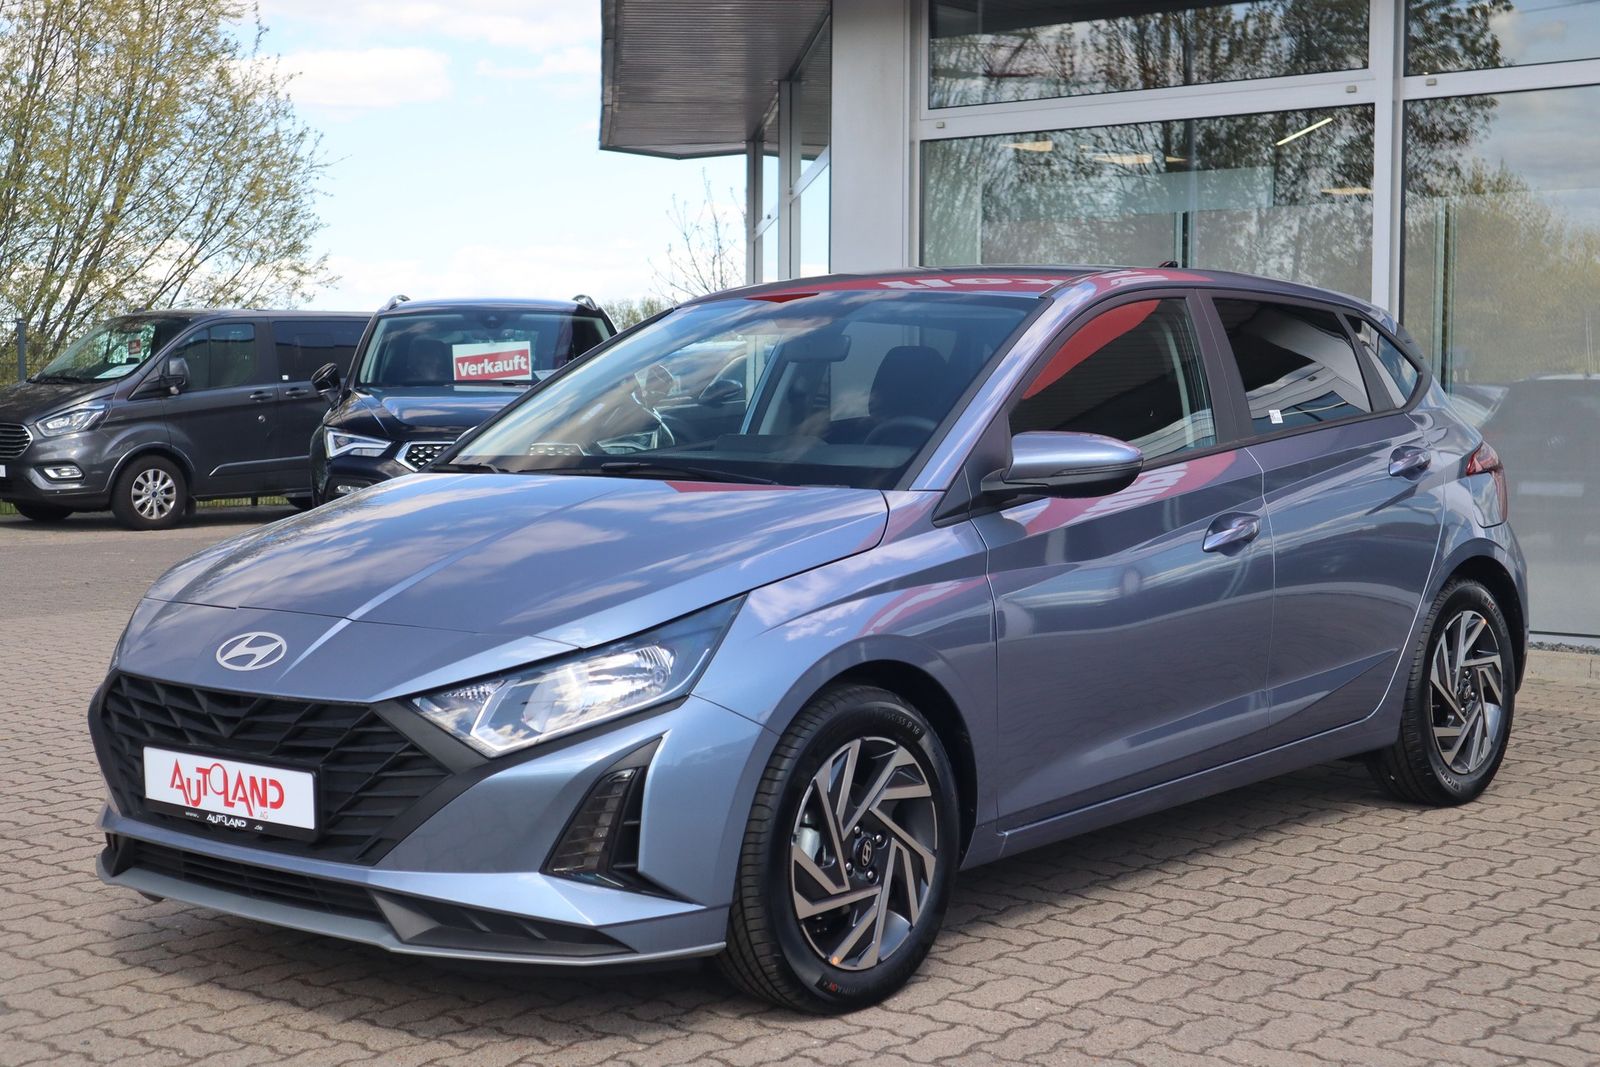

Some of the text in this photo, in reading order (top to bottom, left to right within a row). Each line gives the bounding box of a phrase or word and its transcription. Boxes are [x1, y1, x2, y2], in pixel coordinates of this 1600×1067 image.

[457, 354, 528, 377] Verkauft
[169, 758, 285, 817] AUTOLAND
[206, 813, 247, 829] AUTOLAND
